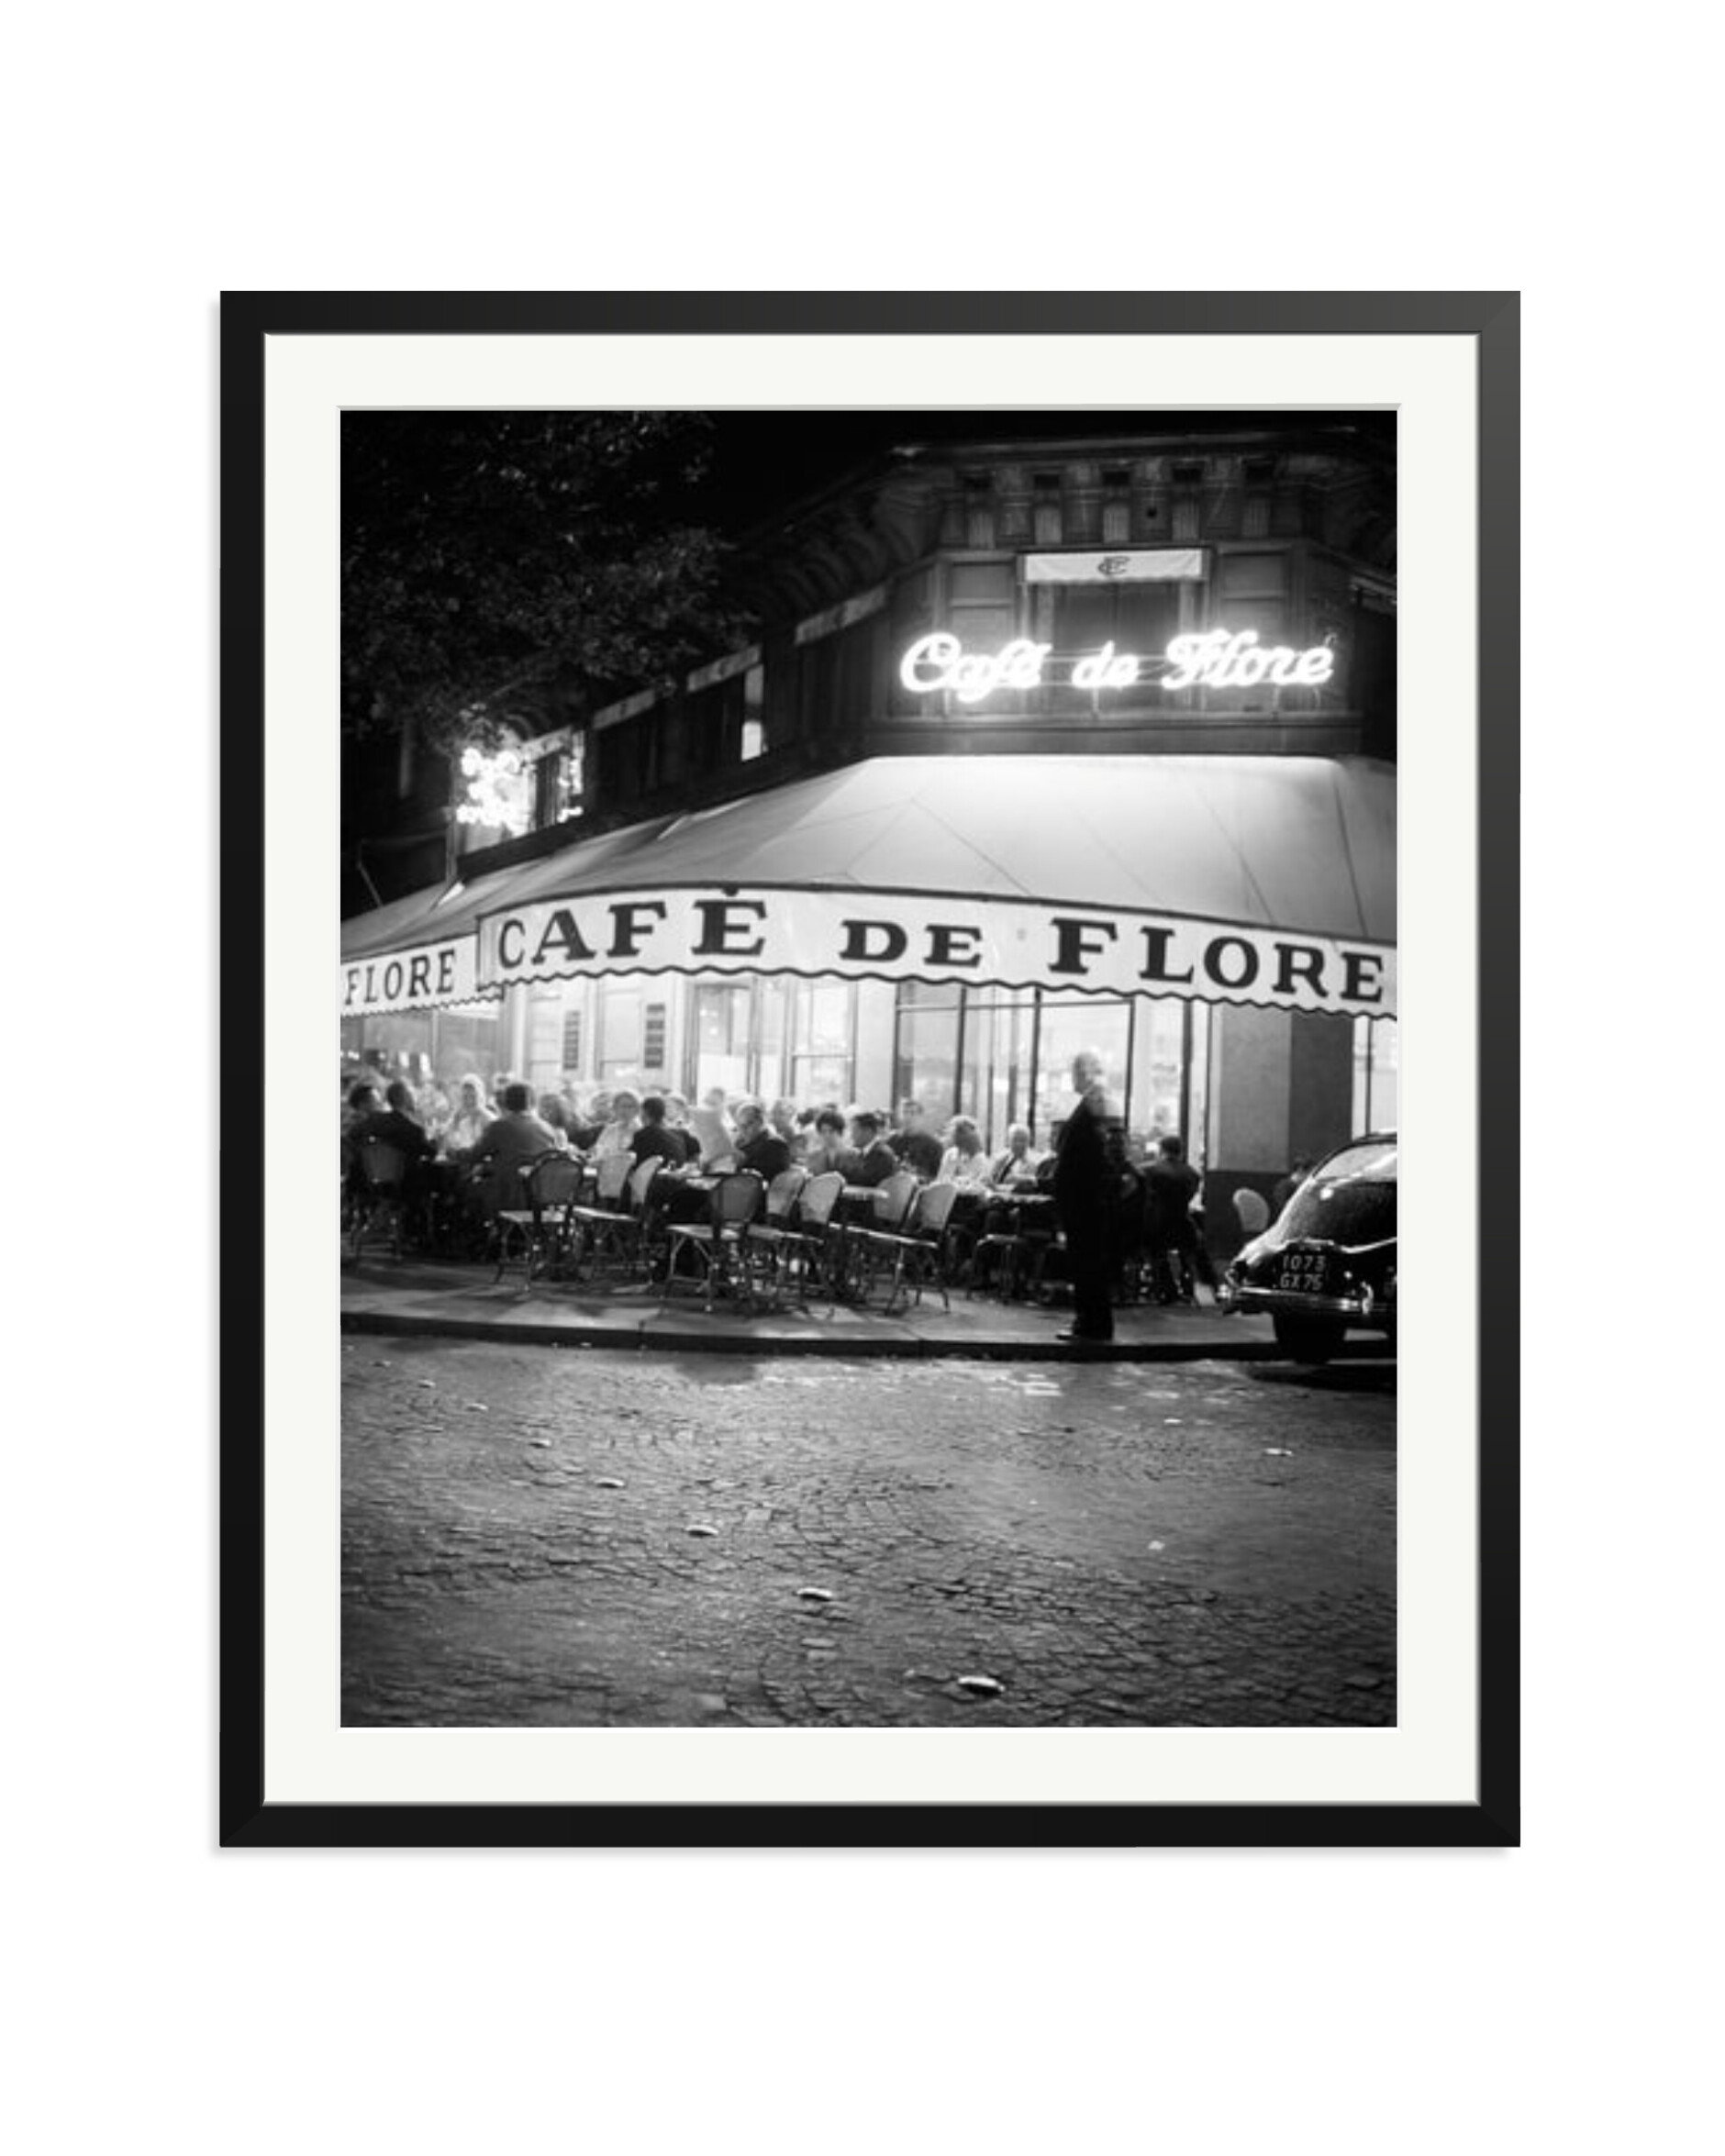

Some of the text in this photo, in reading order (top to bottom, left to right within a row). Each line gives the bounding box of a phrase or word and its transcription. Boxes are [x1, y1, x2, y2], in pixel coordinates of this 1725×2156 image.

[1072, 640, 1139, 689] de
[1161, 628, 1334, 690] Flore
[345, 949, 454, 1006] FLORE
[839, 919, 983, 968] DE
[1049, 917, 1384, 1003] FLORE
